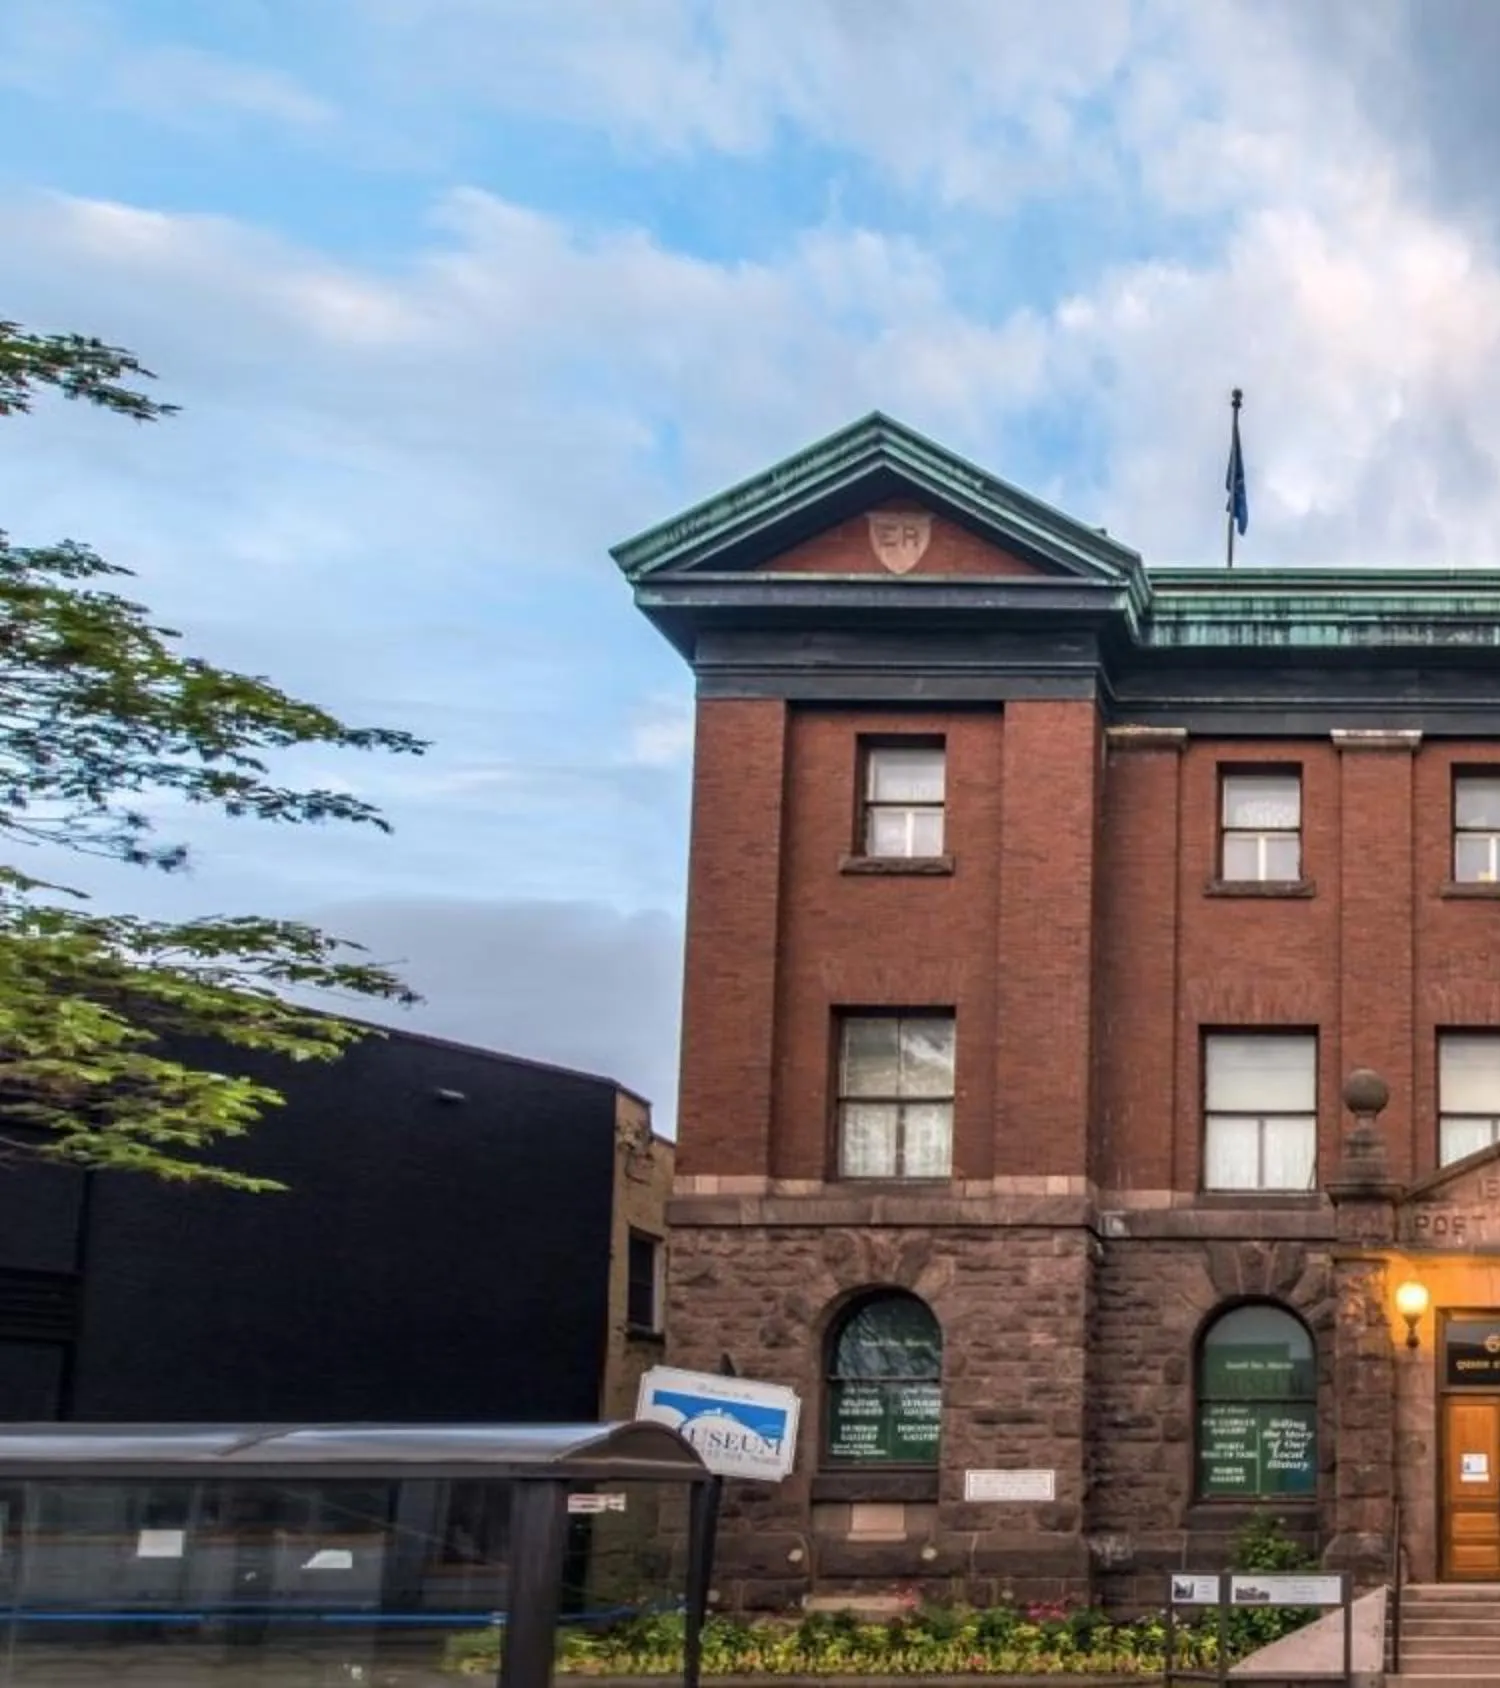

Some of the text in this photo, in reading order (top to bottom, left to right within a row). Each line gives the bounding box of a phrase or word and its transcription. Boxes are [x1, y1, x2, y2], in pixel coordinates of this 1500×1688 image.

[1414, 1214, 1488, 1237] POST
[680, 1426, 784, 1457] USEUM
[1284, 1430, 1314, 1441] Story
[1273, 1449, 1305, 1459] Local
[1267, 1459, 1310, 1472] History
